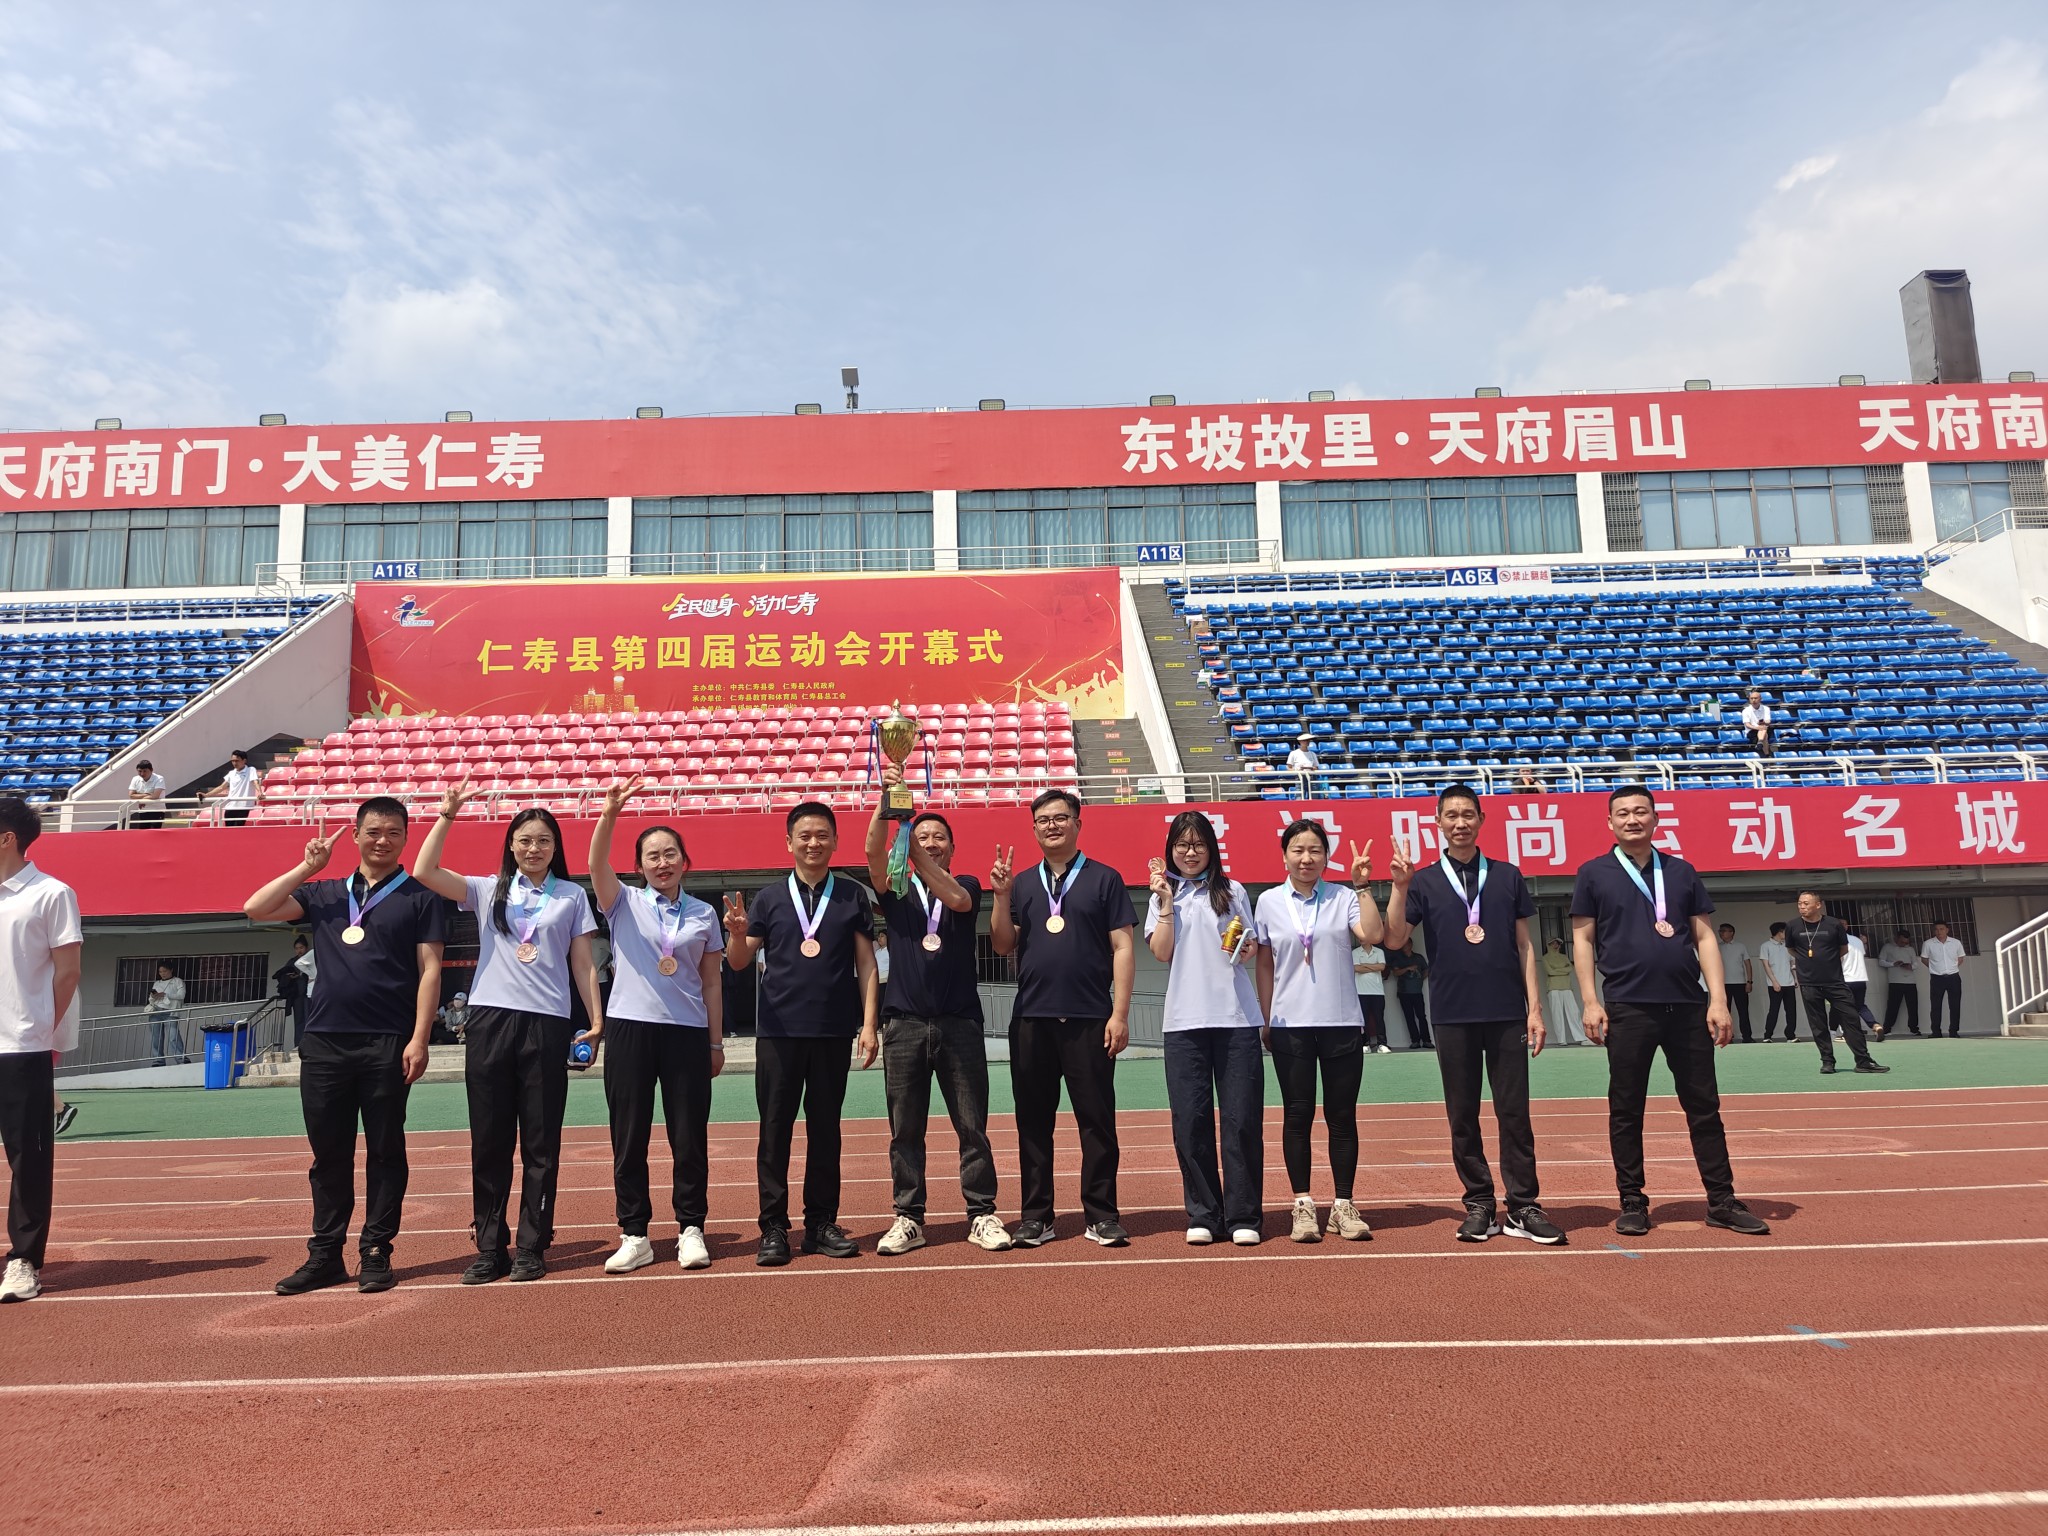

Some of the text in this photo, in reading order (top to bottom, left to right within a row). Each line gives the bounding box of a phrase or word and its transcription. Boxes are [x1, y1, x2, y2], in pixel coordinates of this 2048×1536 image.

[1120, 403, 1687, 474] 东坡故里·天府眉山
[1139, 545, 1182, 560] A11区
[373, 563, 418, 578] A11区
[1450, 569, 1495, 585] A6区
[1511, 570, 1549, 581] 禁止翻越
[477, 629, 1004, 675] 仁寿县第四届运动会开幕式
